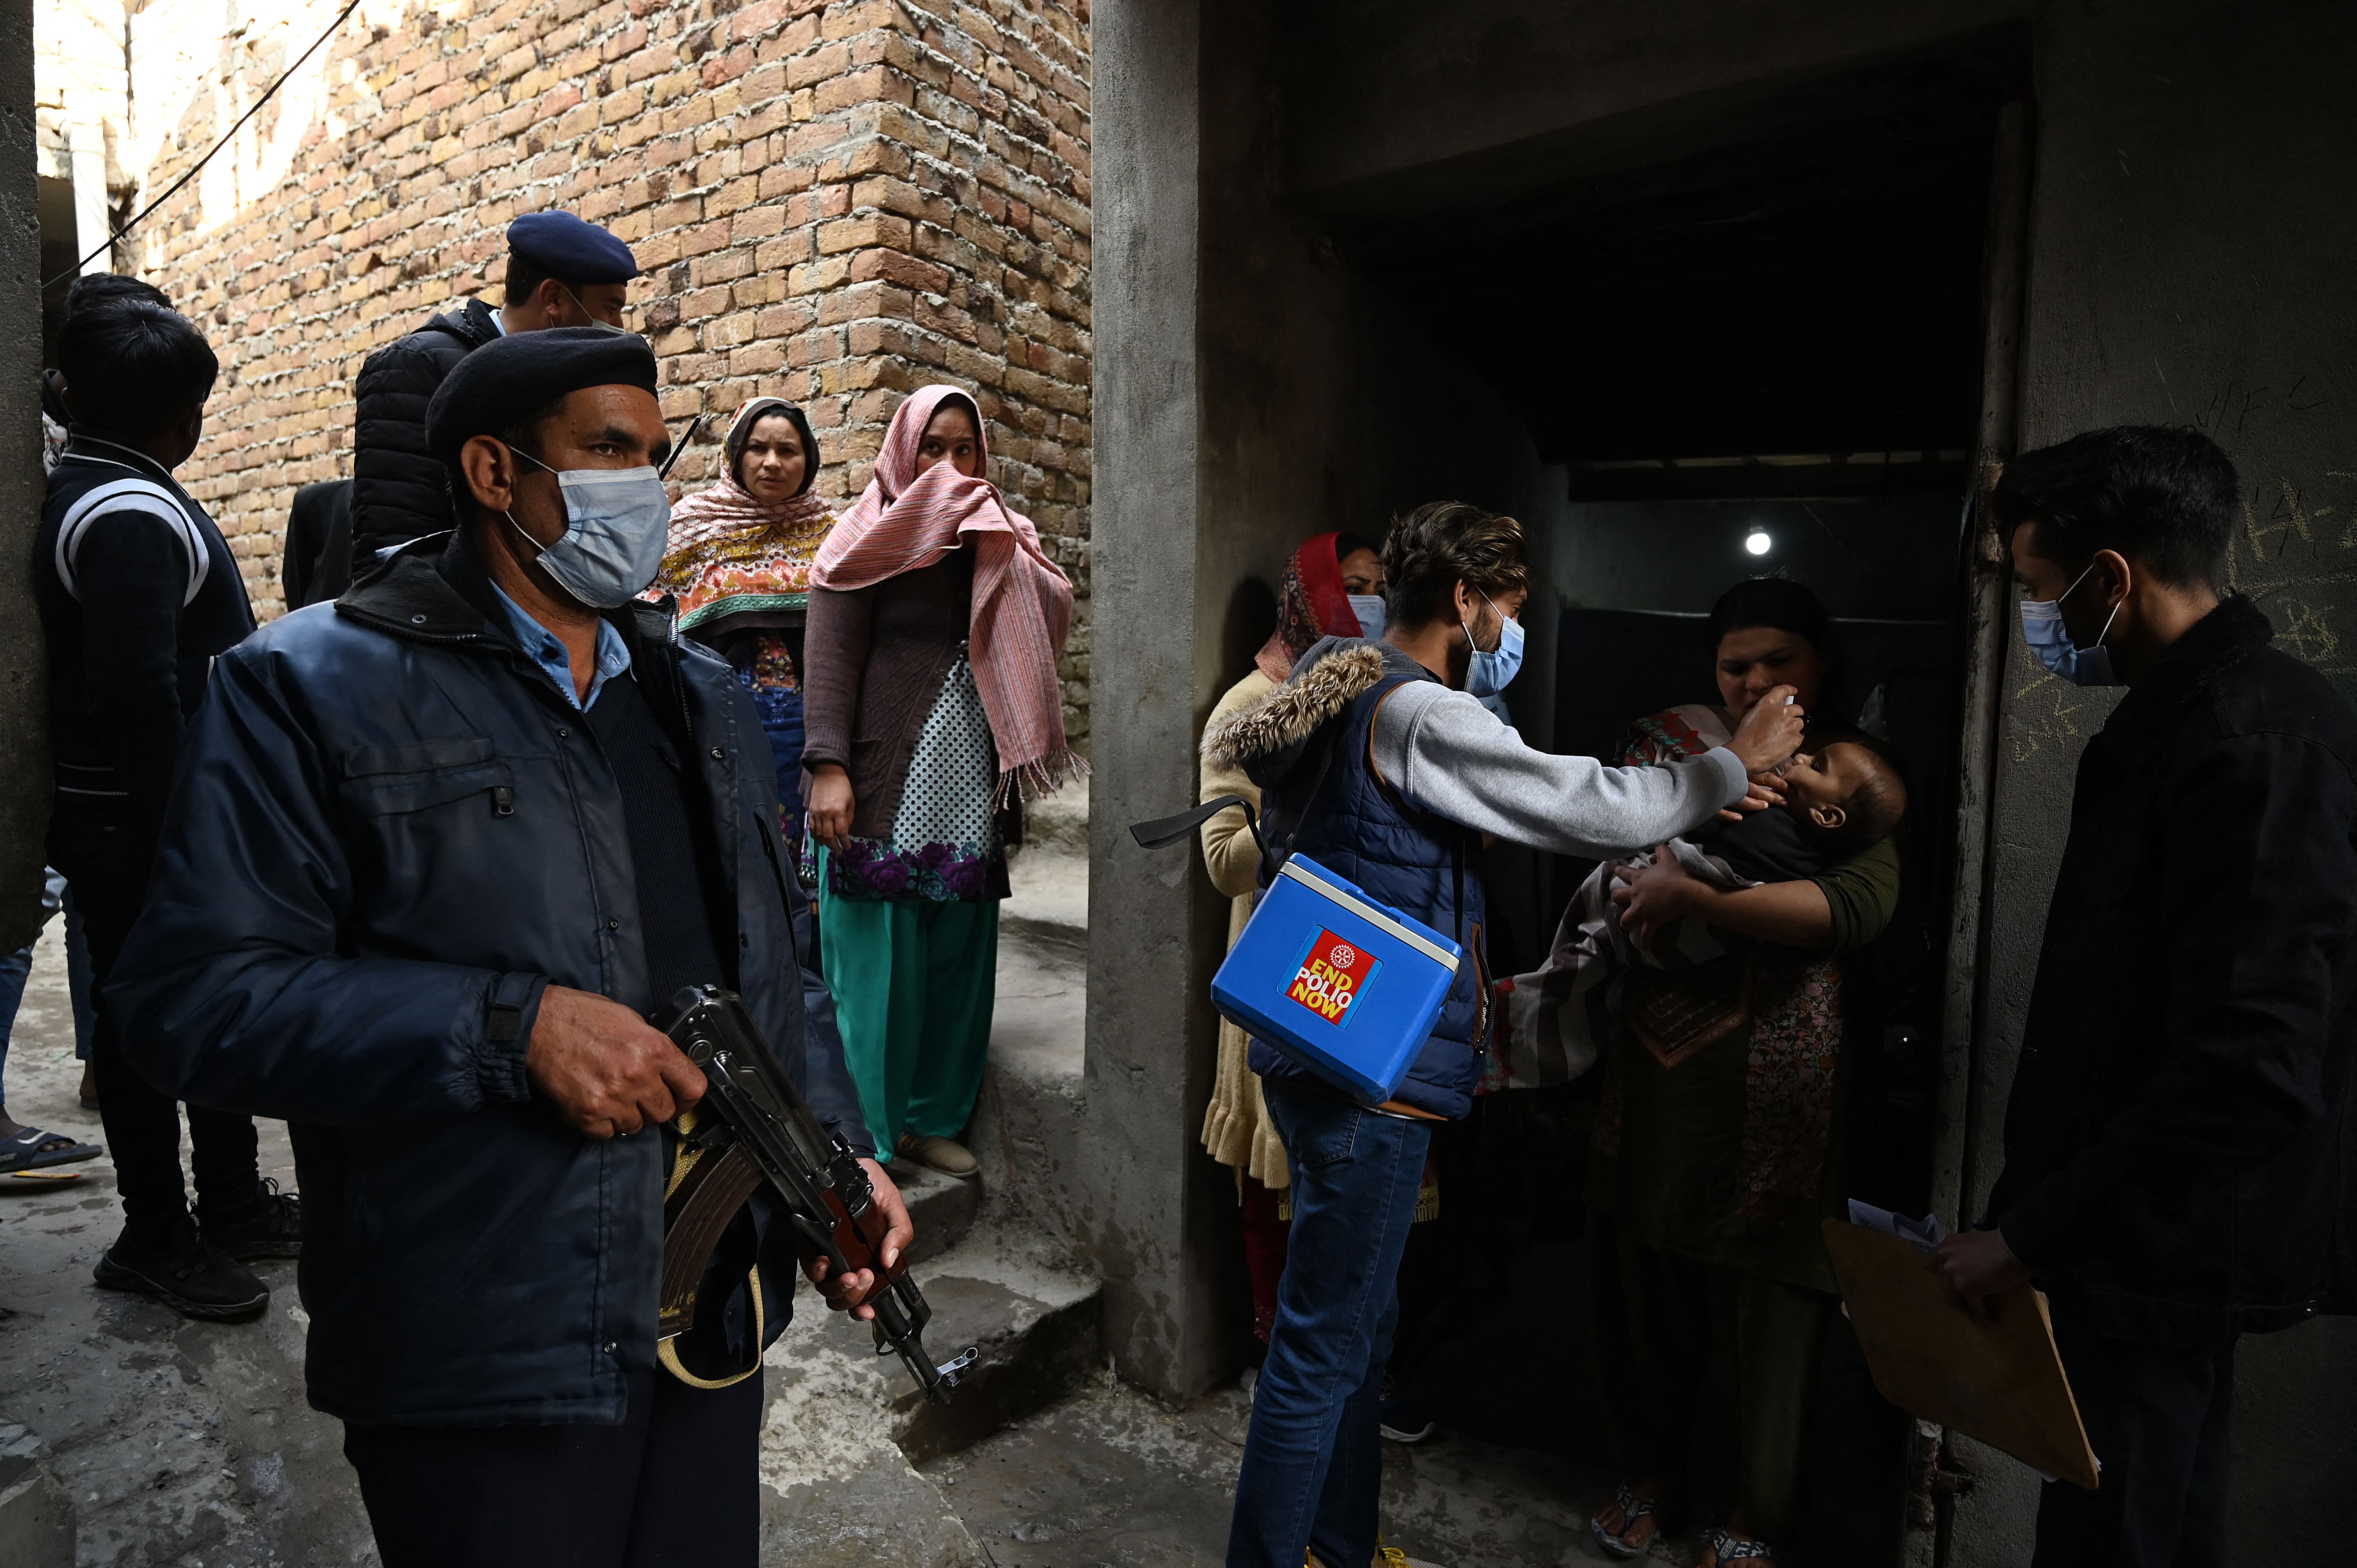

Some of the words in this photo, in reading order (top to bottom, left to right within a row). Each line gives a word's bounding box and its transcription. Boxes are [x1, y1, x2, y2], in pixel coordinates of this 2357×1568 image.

[1294, 966, 1353, 1008] POLIO
[1310, 958, 1352, 991] END
[1292, 982, 1343, 1019] NOW
